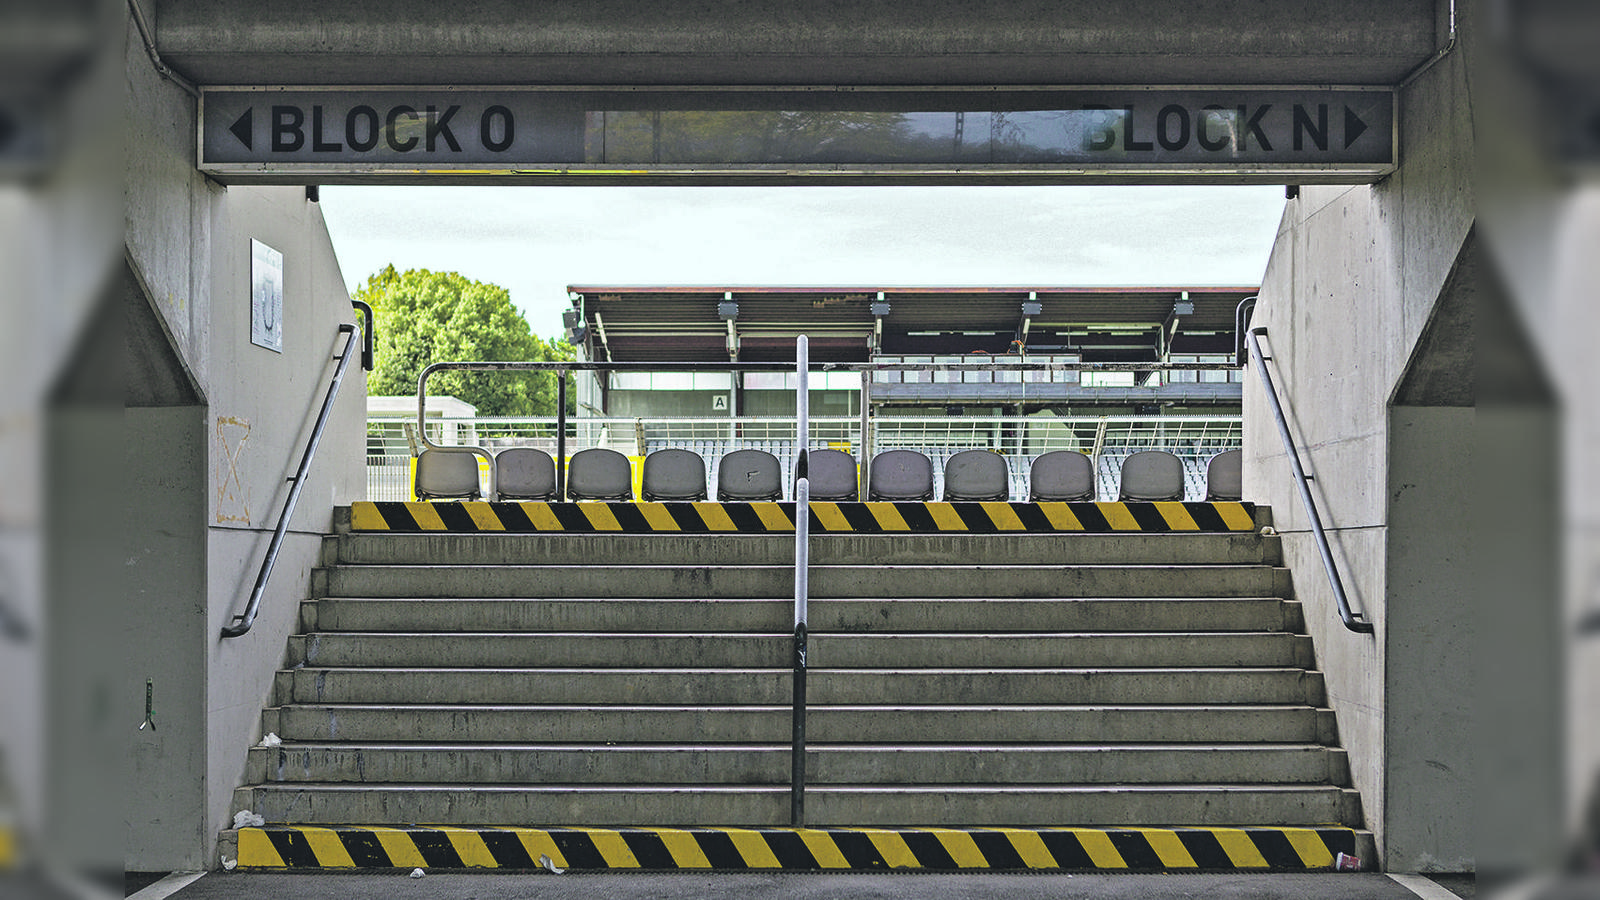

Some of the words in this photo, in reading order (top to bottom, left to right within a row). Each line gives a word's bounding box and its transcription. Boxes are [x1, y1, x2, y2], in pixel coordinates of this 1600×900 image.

[271, 104, 463, 152] BLOCK
[480, 104, 515, 152] O
[1082, 103, 1274, 152] BLOCK
[1292, 103, 1329, 152] N
[715, 396, 725, 408] A
